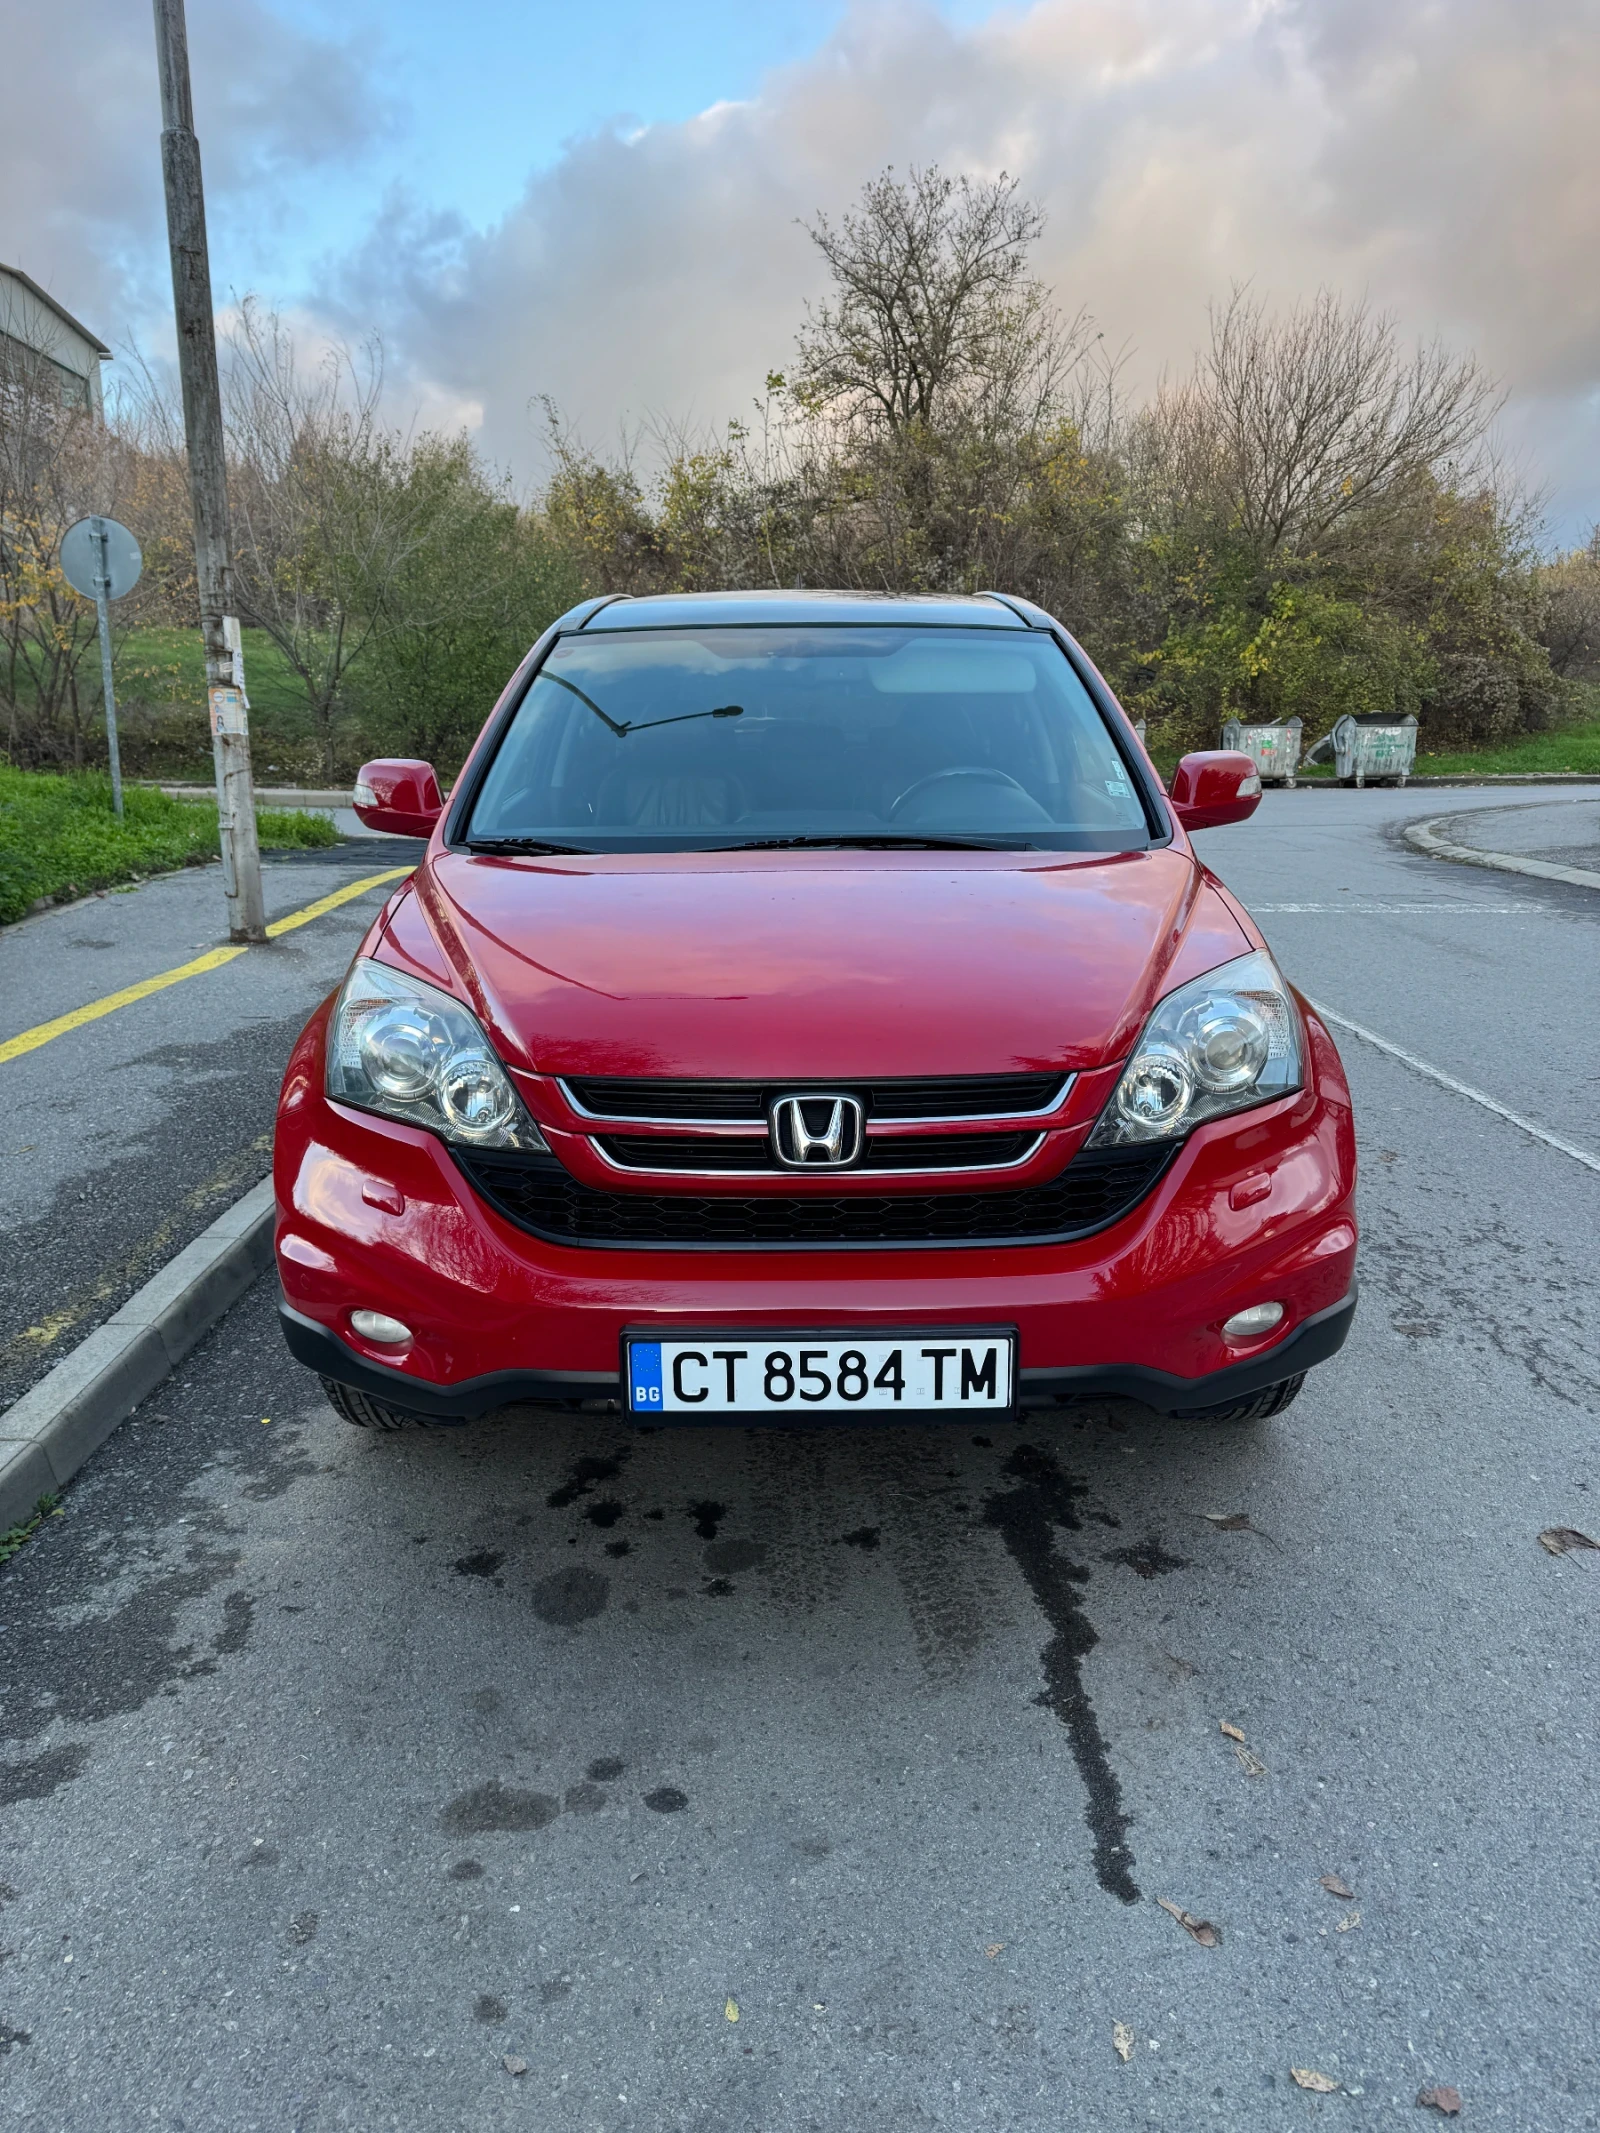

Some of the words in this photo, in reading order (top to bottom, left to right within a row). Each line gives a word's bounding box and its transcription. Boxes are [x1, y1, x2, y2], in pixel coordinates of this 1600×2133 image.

[788, 1098, 845, 1163] H
[635, 1387, 660, 1402] BG
[673, 1351, 748, 1402] CT
[764, 1349, 906, 1402] 8584
[921, 1347, 997, 1401] TM
